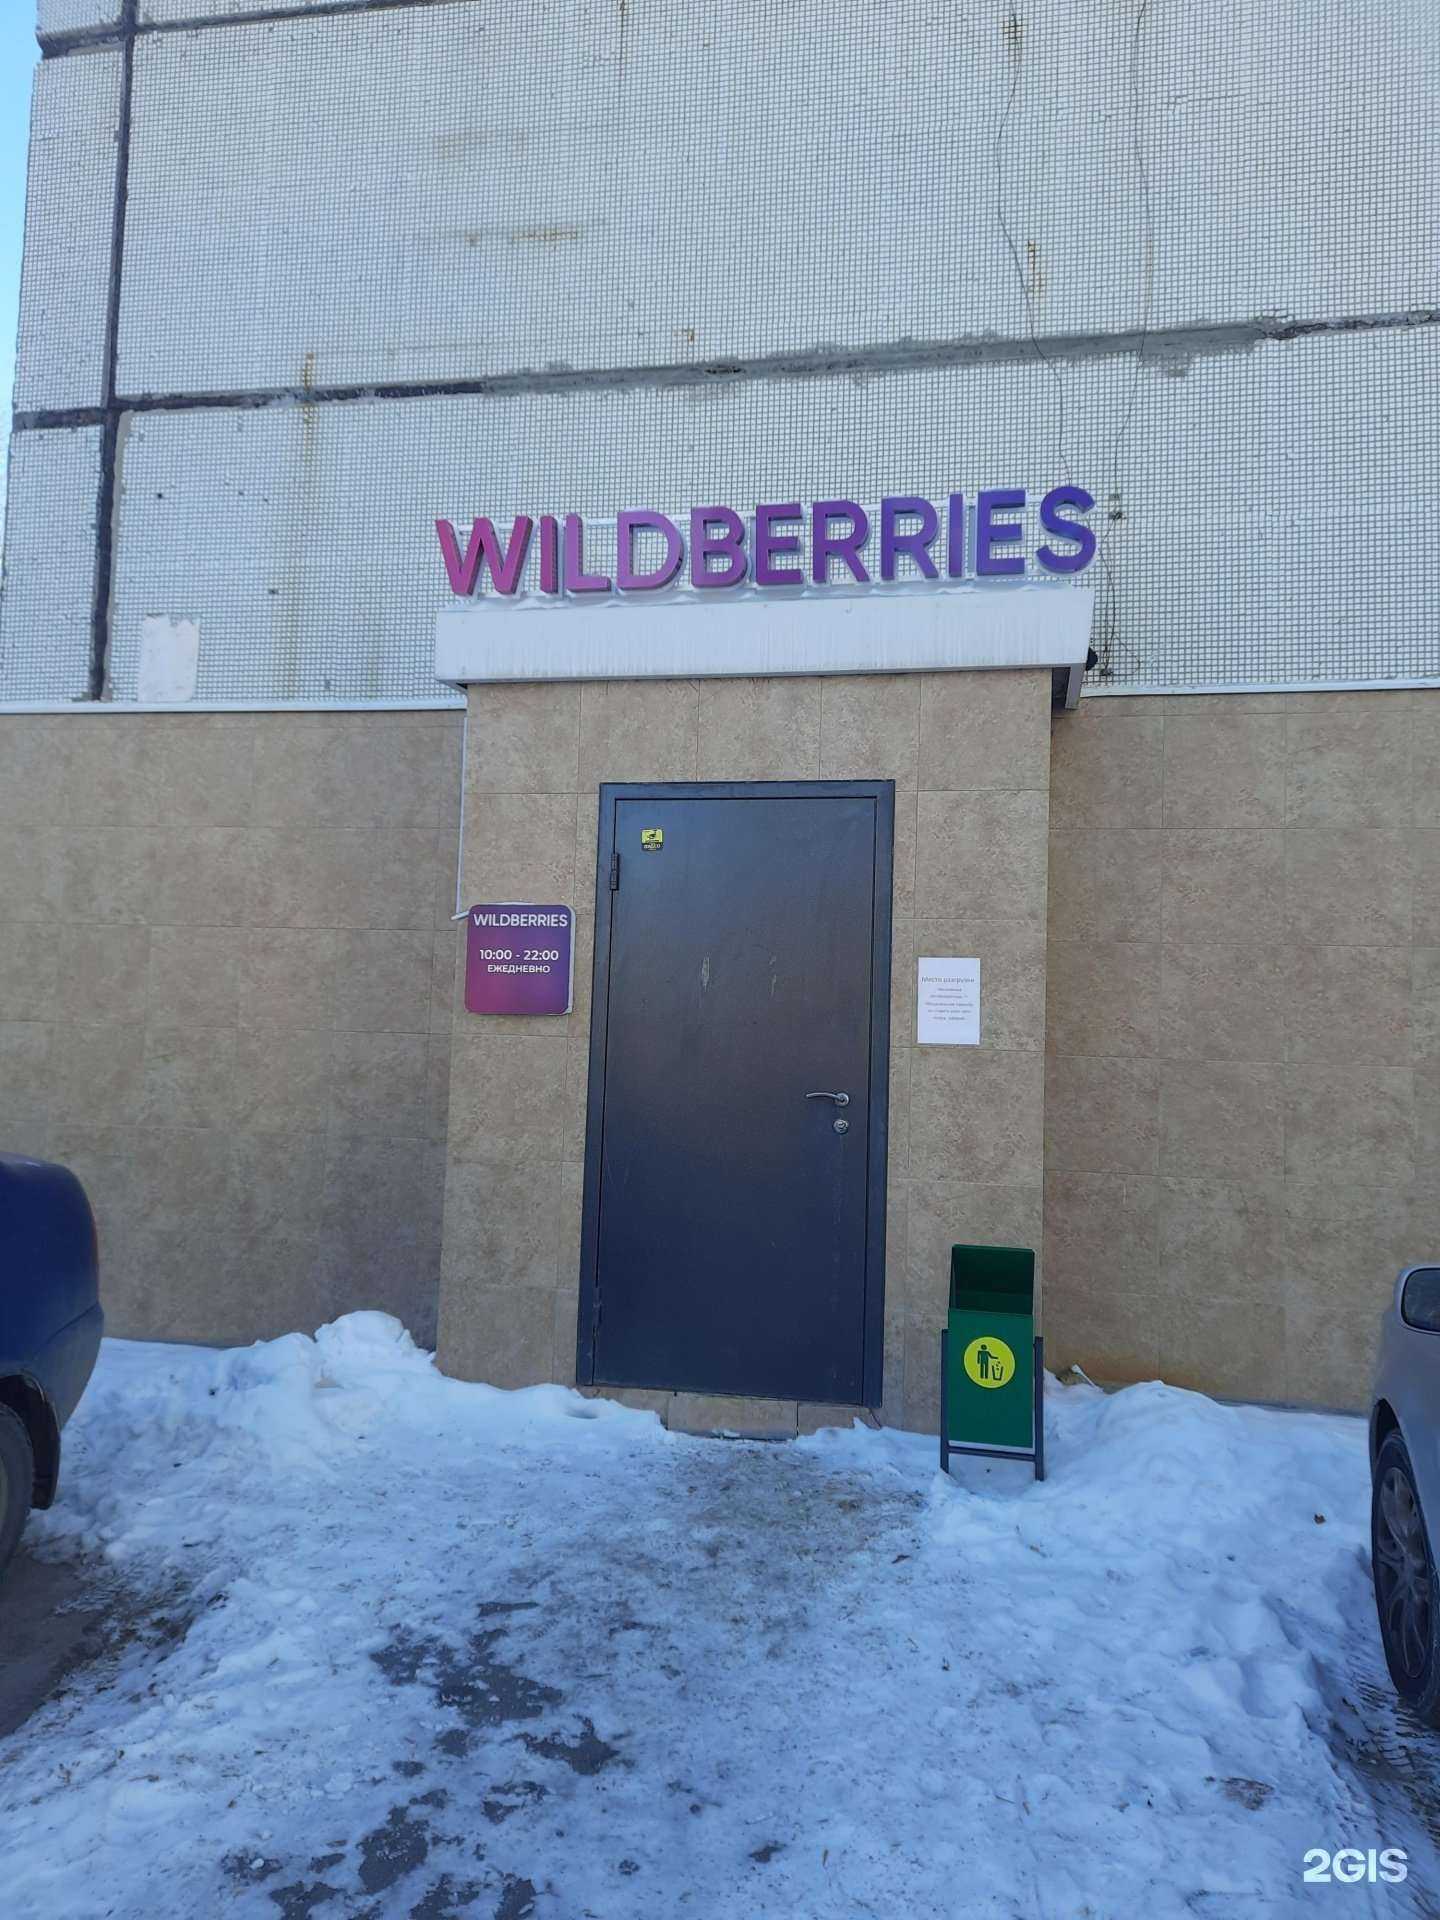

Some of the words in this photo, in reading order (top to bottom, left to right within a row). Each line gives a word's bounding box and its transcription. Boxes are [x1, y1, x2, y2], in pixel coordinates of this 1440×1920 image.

[435, 485, 1097, 597] WILDBERRIES
[473, 913, 568, 927] WILDBERRIES
[479, 949, 512, 960] 10:00
[523, 950, 559, 961] 22:00
[487, 964, 551, 974] ЕЖЕДНЕВНО
